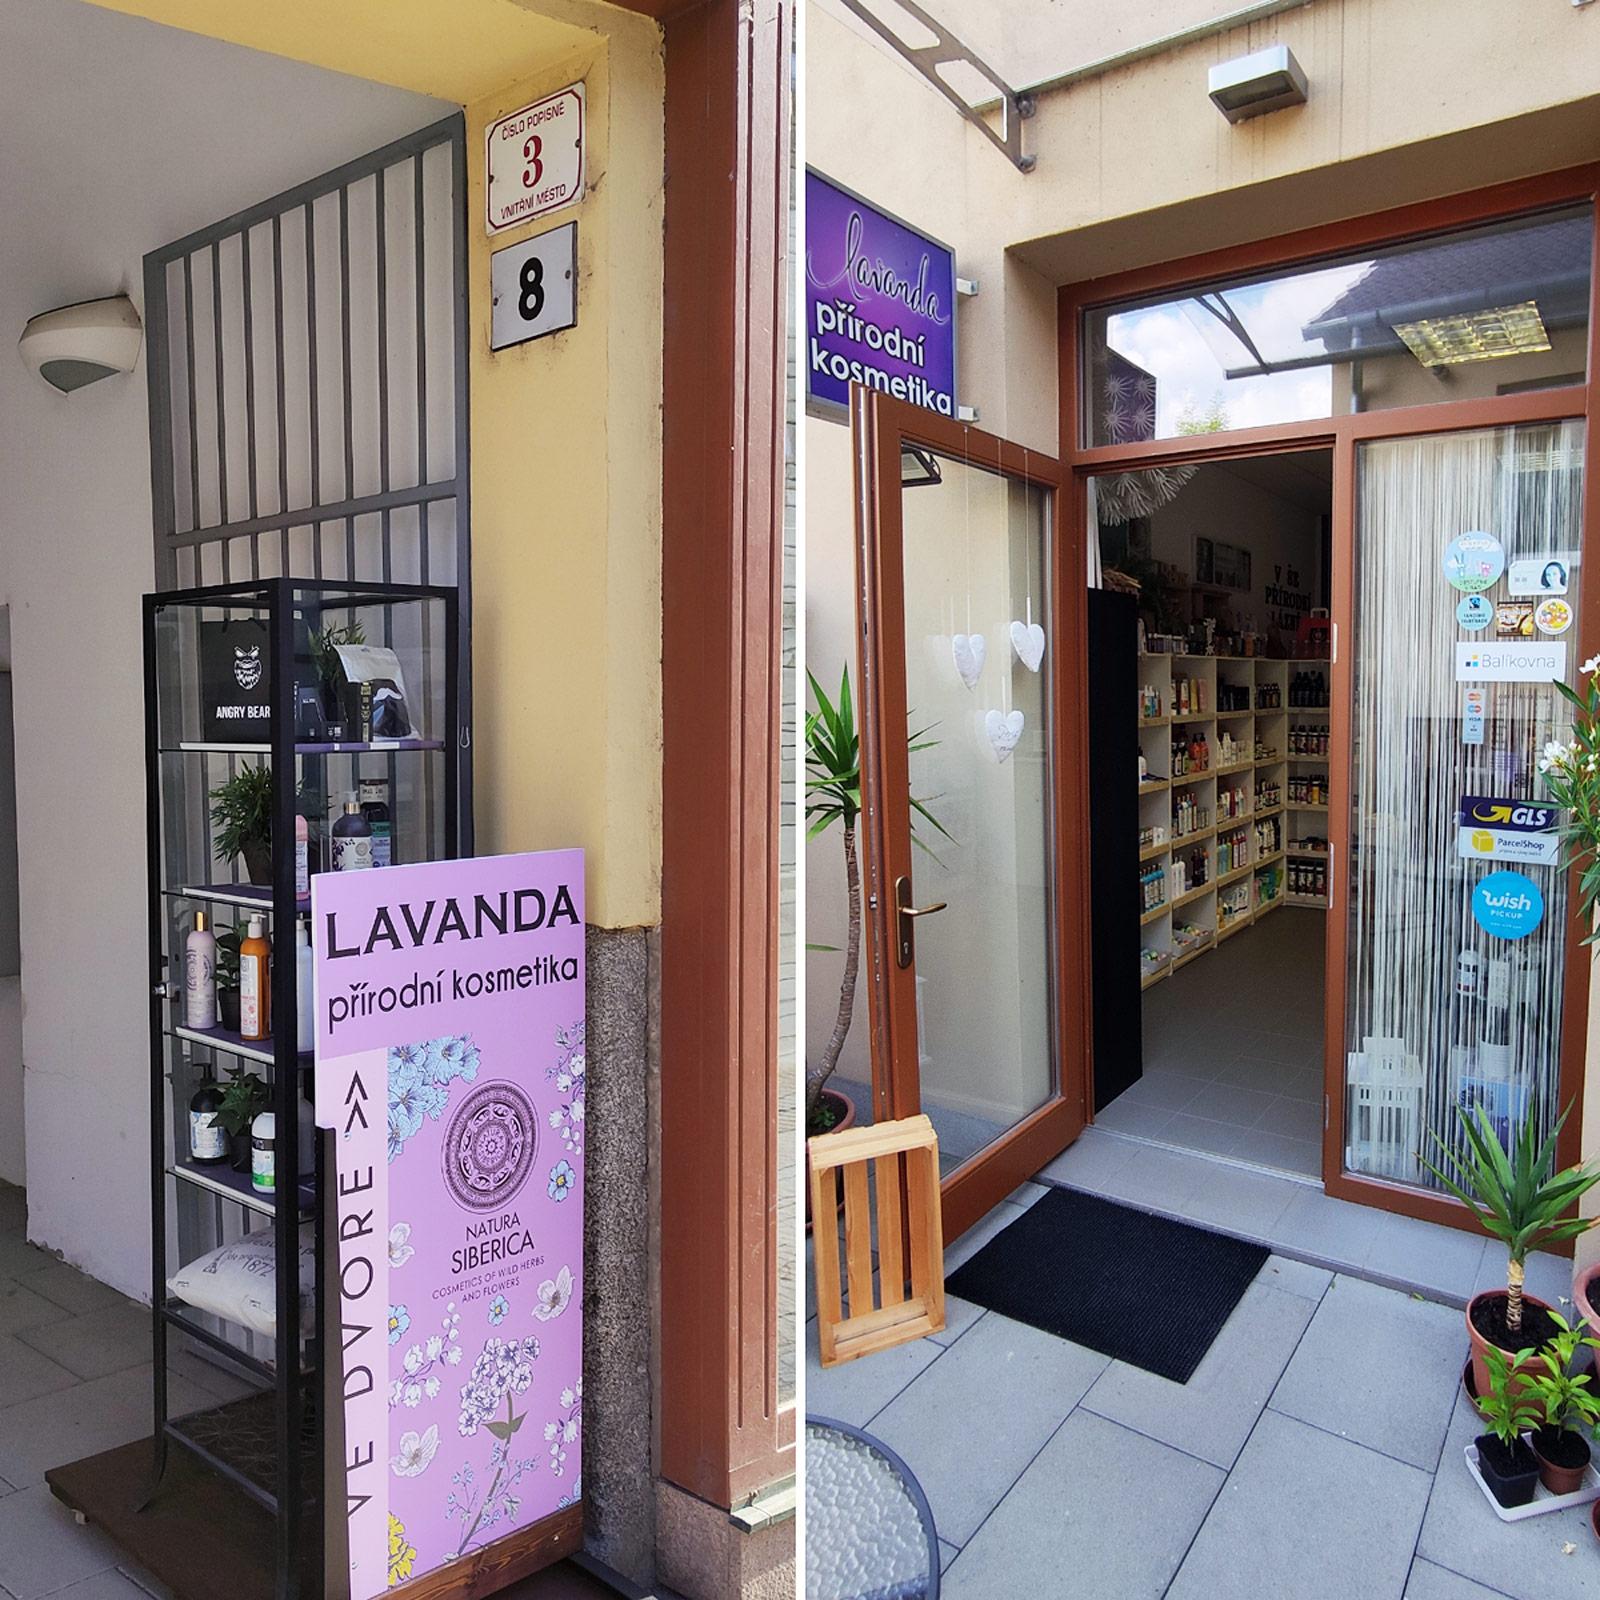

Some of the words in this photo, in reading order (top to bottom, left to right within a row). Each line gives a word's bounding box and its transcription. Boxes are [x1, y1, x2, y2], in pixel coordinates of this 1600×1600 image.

[502, 119, 526, 141] ČÍSLO
[526, 101, 565, 132] POPISNÉ
[522, 135, 543, 188] 3
[500, 196, 534, 220] VNITŘNÍ
[535, 182, 566, 208] MĚSTO
[518, 256, 545, 321] 8
[815, 299, 926, 367] přírodní
[810, 338, 952, 416] kosmetika
[1482, 653, 1556, 668] Balíkovna
[216, 706, 245, 719] ANGRY
[1511, 807, 1547, 827] GLS
[1497, 838, 1545, 851] ParcelShop
[1482, 888, 1531, 911] wish
[1490, 910, 1523, 920] PICKUP
[326, 885, 581, 960] LAVANDA
[328, 968, 444, 1034] přírodní
[452, 954, 579, 999] kosmetika
[466, 1211, 521, 1241] NATURA
[451, 1229, 535, 1274] SIBERICA
[432, 1275, 483, 1300] COSMETICS
[484, 1272, 497, 1283] OF
[498, 1263, 519, 1281] WILD
[519, 1255, 545, 1272] HERBS
[462, 1289, 481, 1304] AND
[482, 1277, 520, 1298] FLOWERS
[346, 1440, 375, 1520] VE
